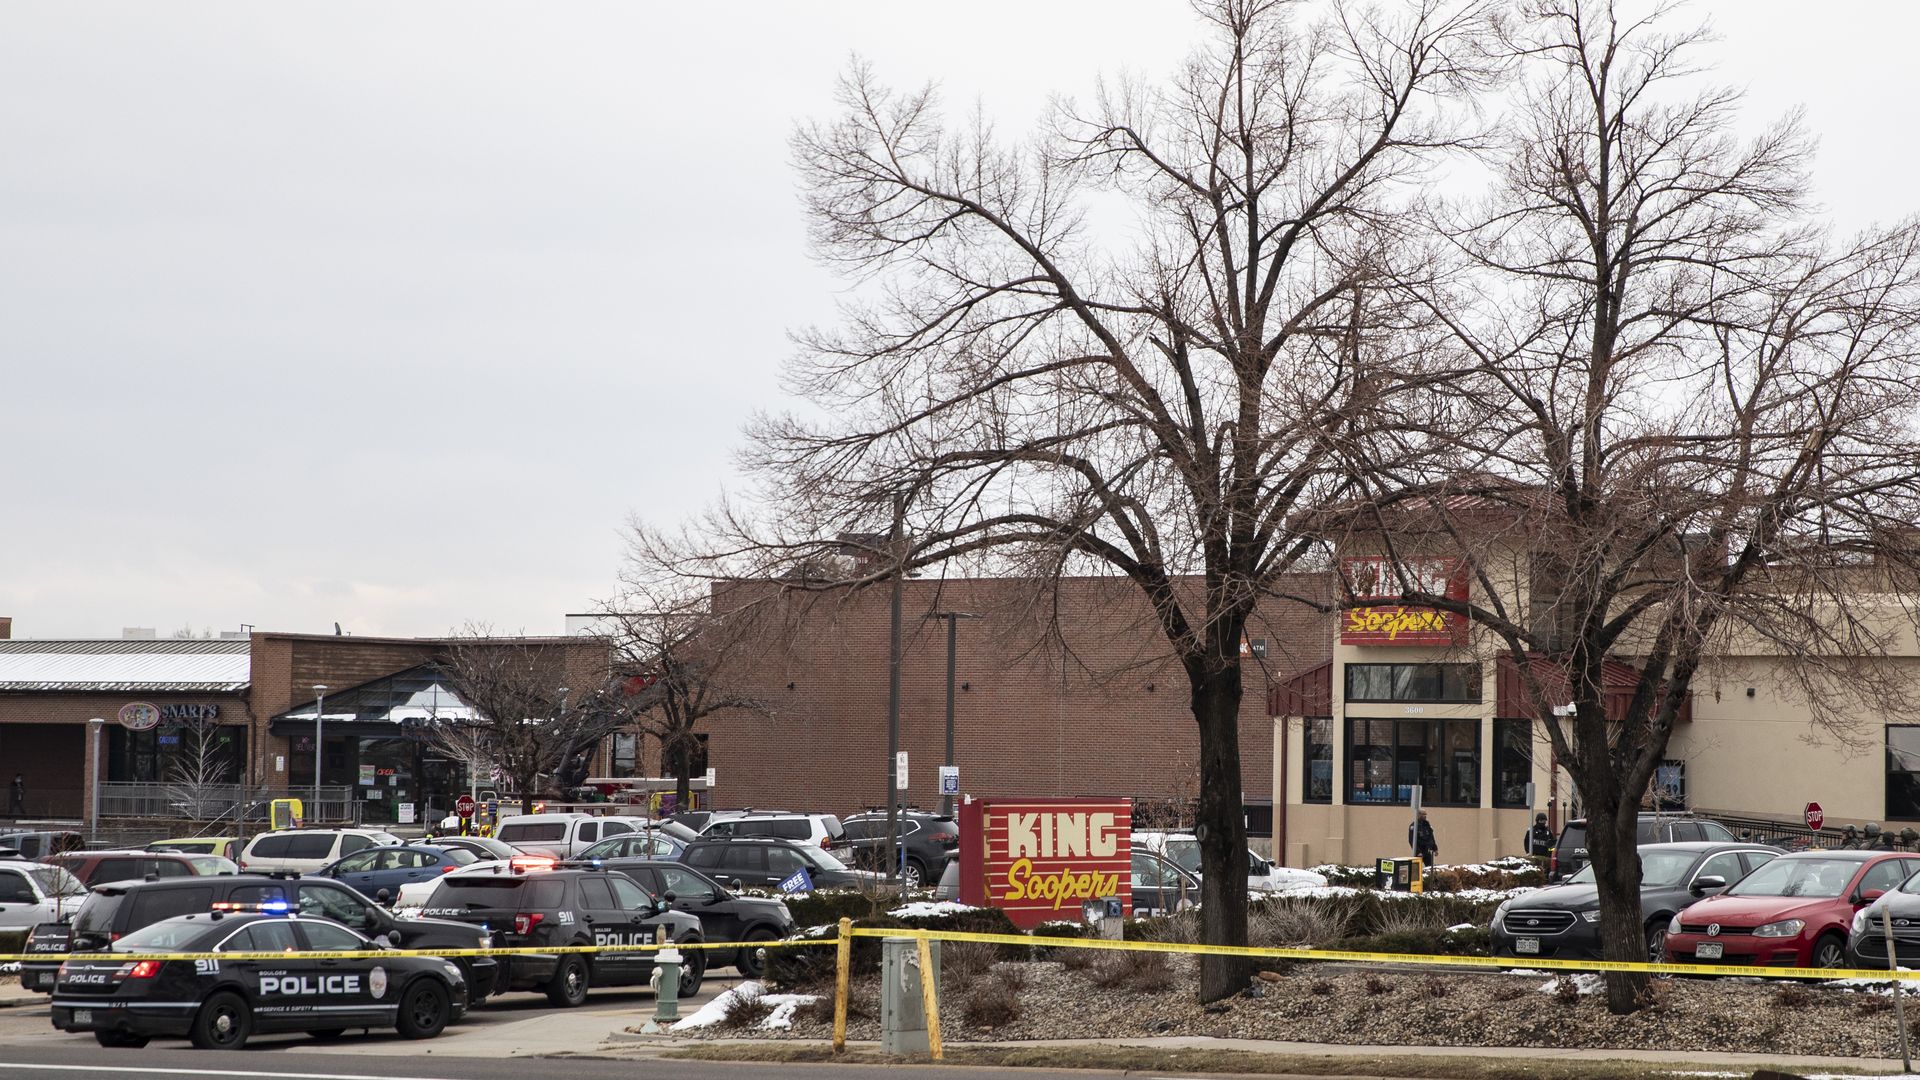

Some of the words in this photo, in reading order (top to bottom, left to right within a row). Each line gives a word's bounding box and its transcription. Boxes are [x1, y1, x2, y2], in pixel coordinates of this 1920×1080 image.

[1404, 706, 1424, 714] 3600
[458, 802, 474, 812] STOP
[1808, 810, 1822, 822] STOP
[1008, 812, 1116, 858] KING
[782, 872, 804, 892] FREE
[1004, 858, 1118, 910] Soopers
[423, 908, 460, 916] POLICE
[558, 911, 574, 922] 911
[595, 933, 652, 946] POLICE
[194, 959, 219, 971] 911
[69, 974, 106, 984] POLICE
[260, 976, 360, 995] POLICE
